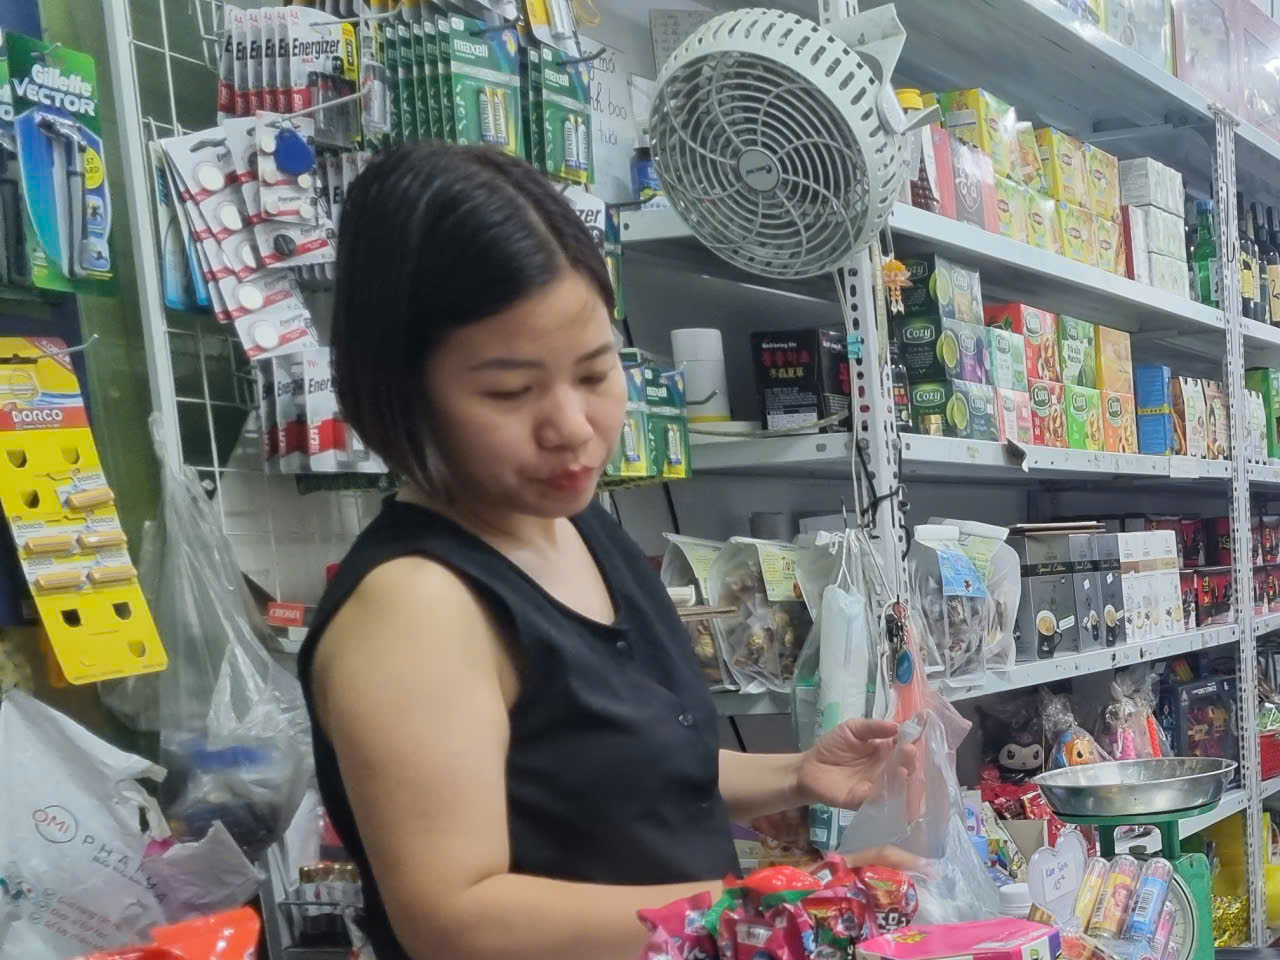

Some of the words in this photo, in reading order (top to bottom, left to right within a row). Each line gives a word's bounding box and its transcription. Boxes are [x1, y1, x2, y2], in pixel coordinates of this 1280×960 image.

[292, 39, 341, 60] Energizer
[454, 38, 489, 58] maxell
[31, 63, 93, 98] Gillette
[12, 77, 96, 117] VECTOR
[905, 262, 924, 276] ozy
[953, 274, 968, 289] Cozy
[906, 327, 931, 341] Cozy
[961, 334, 974, 348] Cozy
[916, 388, 941, 402] Cozy
[1034, 388, 1049, 402] Cozy
[1073, 395, 1087, 409] Cozy
[971, 397, 985, 411] Cozy
[1108, 401, 1122, 415] Cozy
[12, 408, 64, 424] DORCO
[31, 808, 70, 835] OMI
